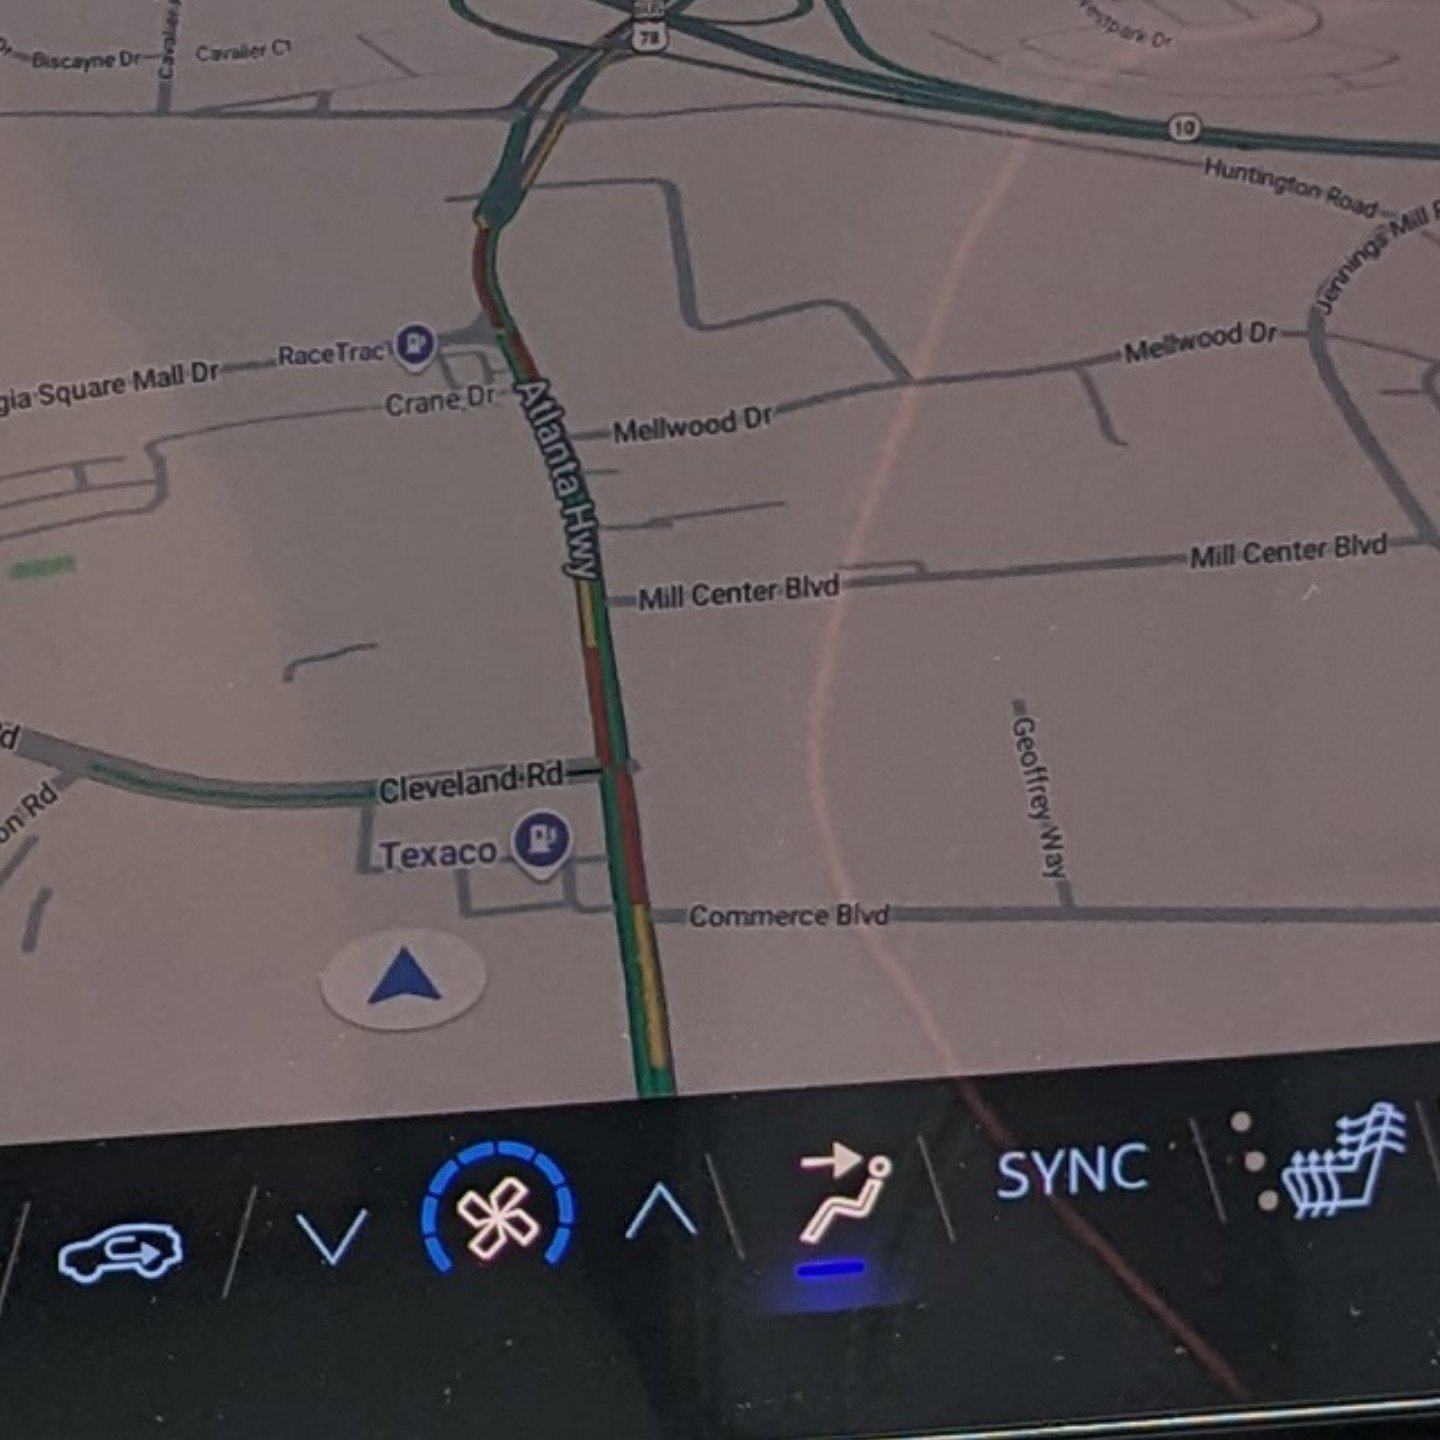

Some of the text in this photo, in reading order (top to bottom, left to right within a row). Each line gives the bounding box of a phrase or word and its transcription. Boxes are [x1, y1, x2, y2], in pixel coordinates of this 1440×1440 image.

[31, 48, 141, 73] Biscayne Dr
[1174, 120, 1196, 137] 10
[1203, 157, 1380, 219] Huntington Road
[1316, 227, 1388, 314] Jennings
[1389, 204, 1430, 240] Mill
[1124, 319, 1279, 364] Mellwood Dr
[37, 372, 126, 410] Square
[132, 364, 186, 394] Mall
[190, 360, 220, 387] Dr
[385, 383, 496, 418] Crane Dr
[613, 404, 773, 444] Mellwood Dr
[517, 377, 599, 581] Atlanta Hwy
[1190, 531, 1389, 569] Mill Center Blvd
[638, 571, 842, 611] Mill Center Blvd
[20, 779, 59, 818] Rd
[378, 759, 565, 806] Cleveland Rd
[1013, 715, 1069, 882] Geoffrey Way
[379, 838, 498, 871] Texaco
[688, 902, 892, 931] Commerce Blvd
[996, 1140, 1152, 1202] SYNC
